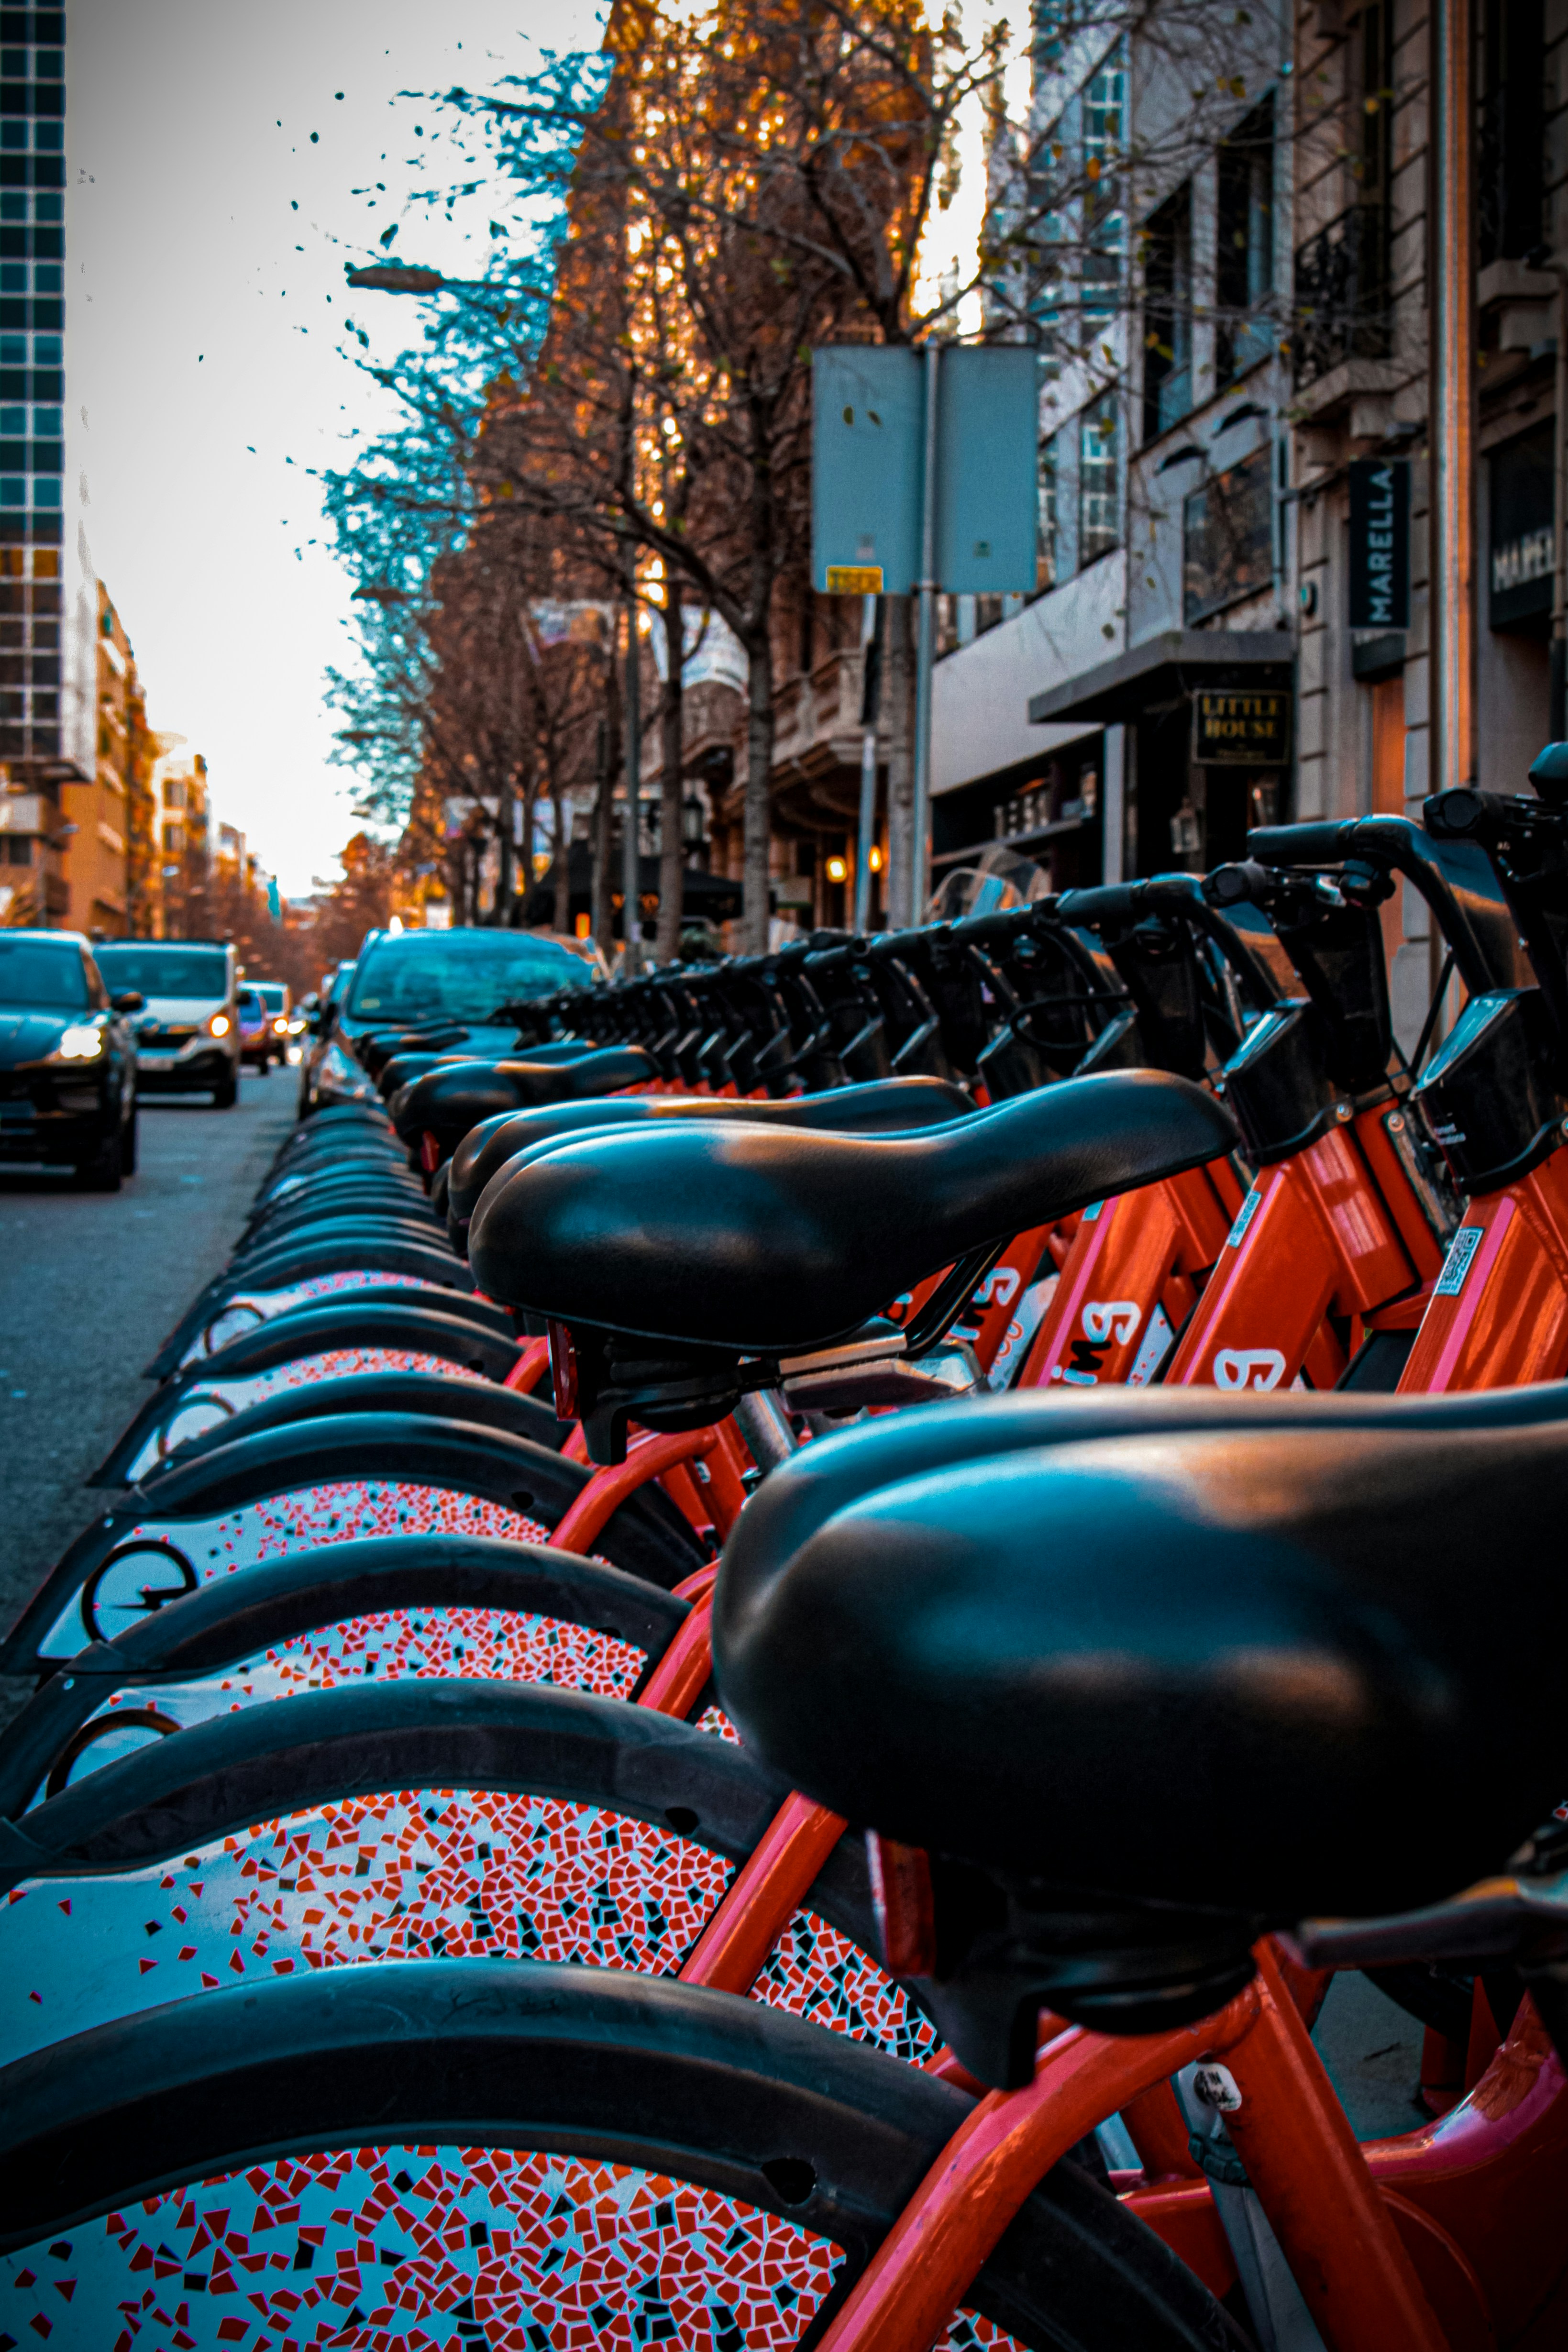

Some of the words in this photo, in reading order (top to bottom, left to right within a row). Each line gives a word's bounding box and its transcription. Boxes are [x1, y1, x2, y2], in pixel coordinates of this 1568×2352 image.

[1368, 467, 1394, 622] MARELLA
[1493, 529, 1556, 593] MAREL
[1202, 696, 1280, 717] LITTLE
[1204, 719, 1277, 738] HOUSE
[1051, 1301, 1141, 1385] ing
